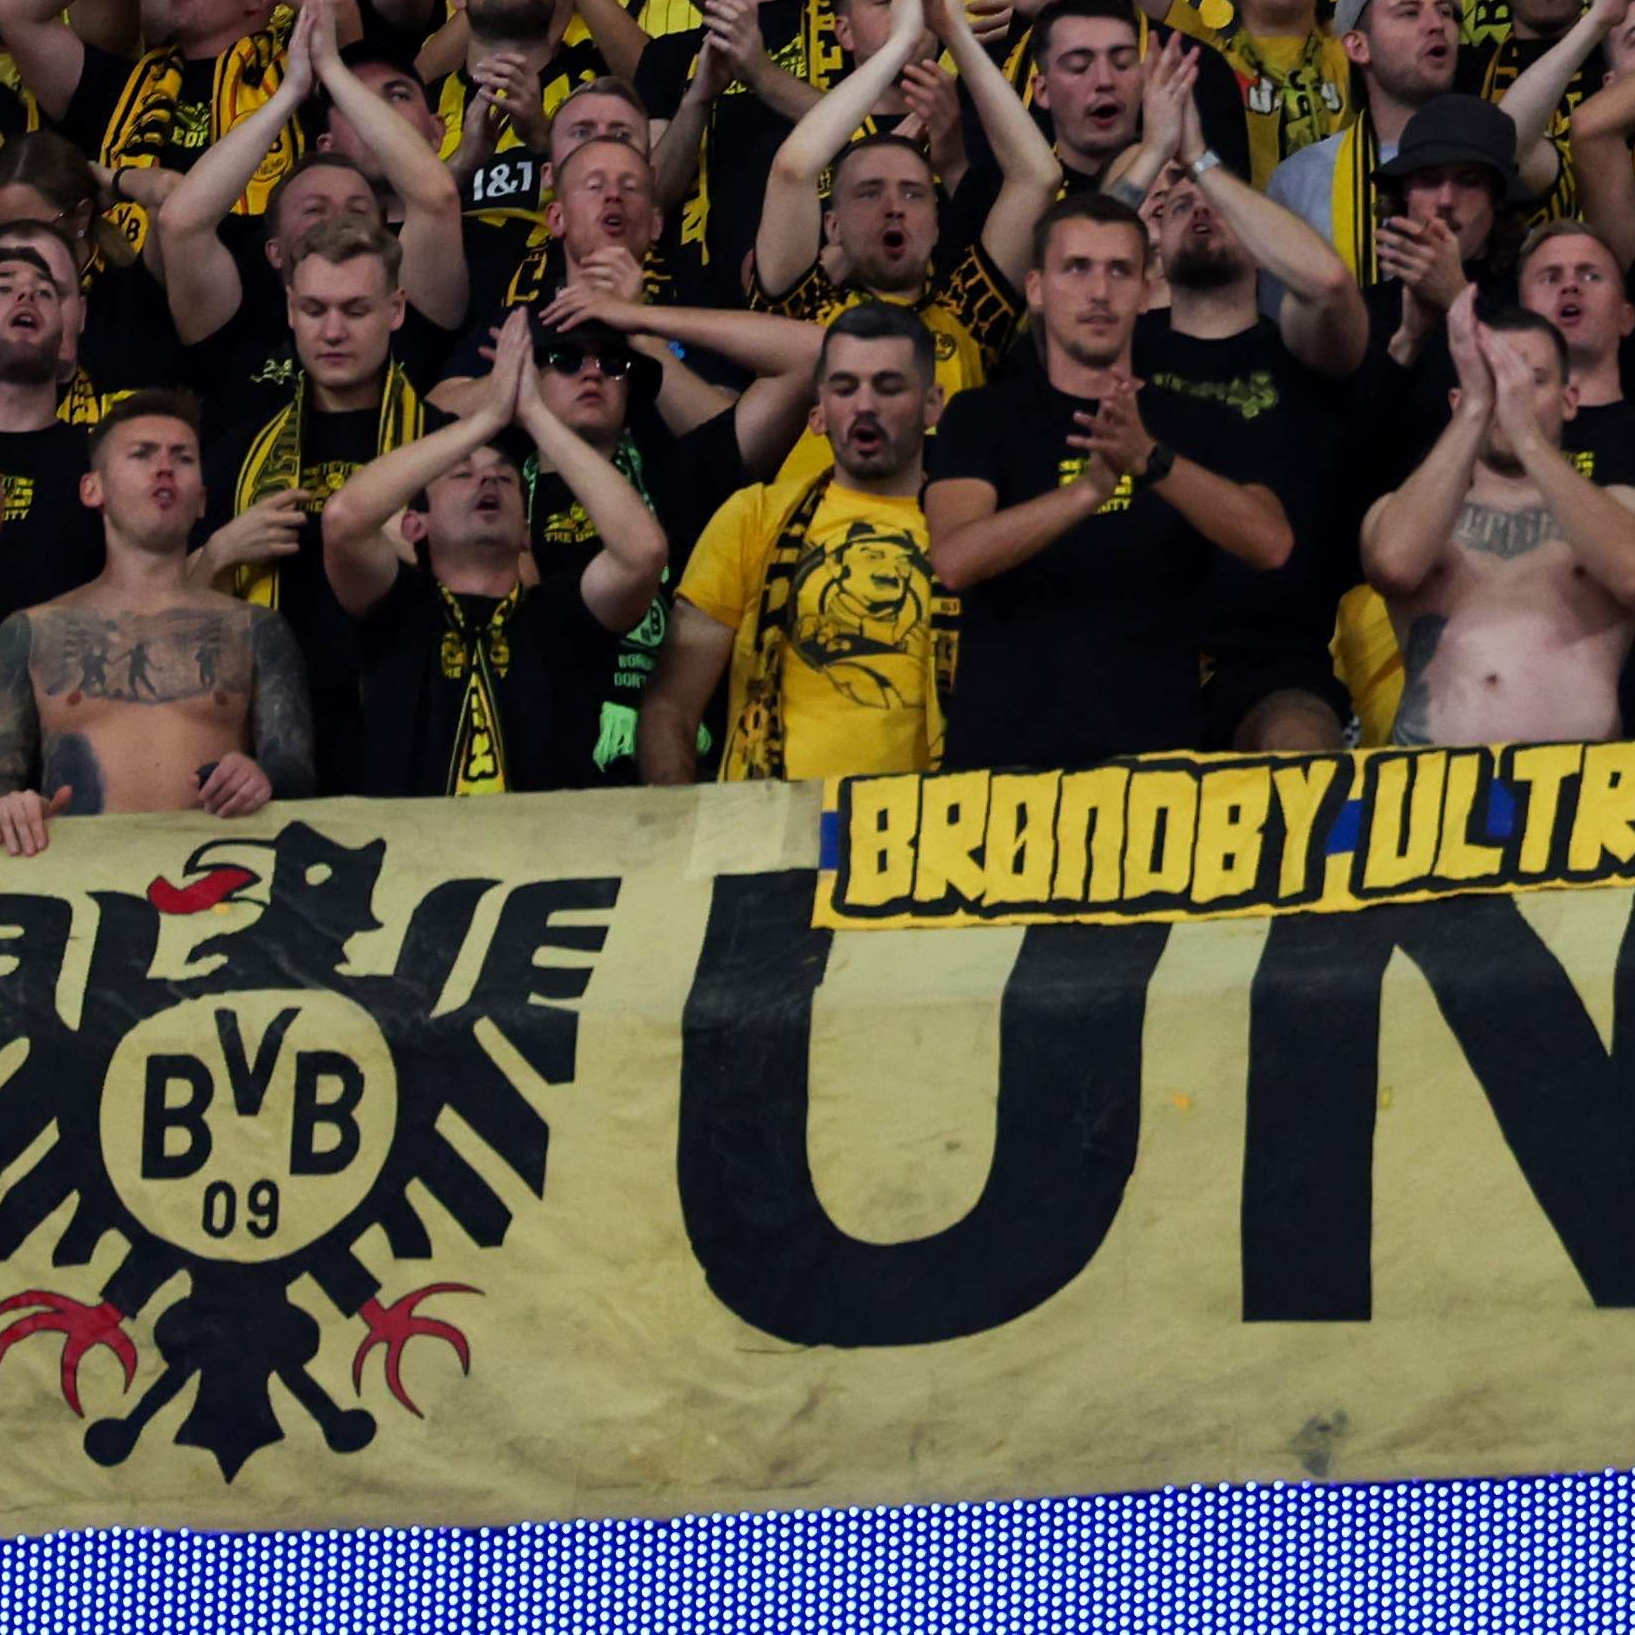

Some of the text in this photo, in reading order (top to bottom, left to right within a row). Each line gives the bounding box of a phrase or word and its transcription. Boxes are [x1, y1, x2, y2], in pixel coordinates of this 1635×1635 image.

[472, 161, 534, 202] 1&1
[140, 1006, 366, 1181] BVB
[201, 1179, 280, 1239] 09
